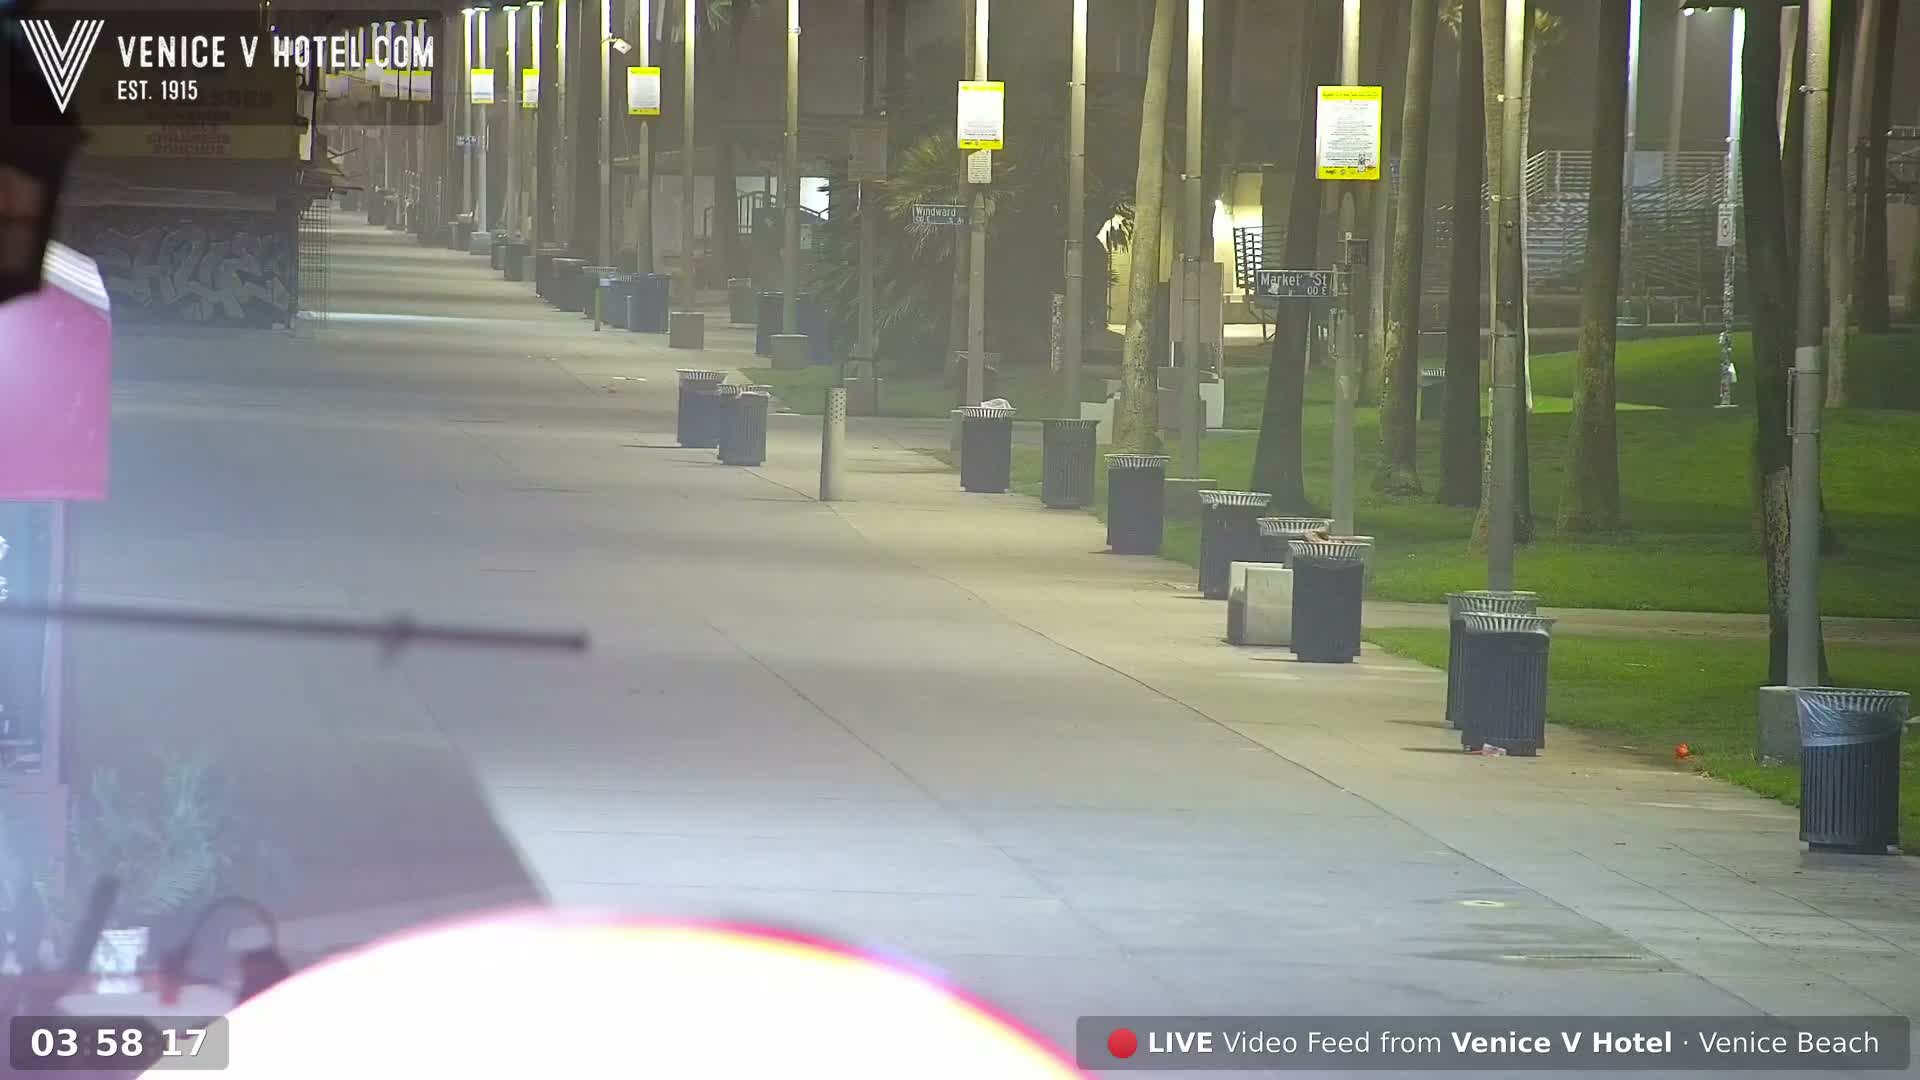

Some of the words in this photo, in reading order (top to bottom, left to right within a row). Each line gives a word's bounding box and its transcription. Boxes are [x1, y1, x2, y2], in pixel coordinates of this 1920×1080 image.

[916, 207, 956, 217] Windward
[1260, 273, 1300, 286] Market
[1314, 273, 1328, 286] St
